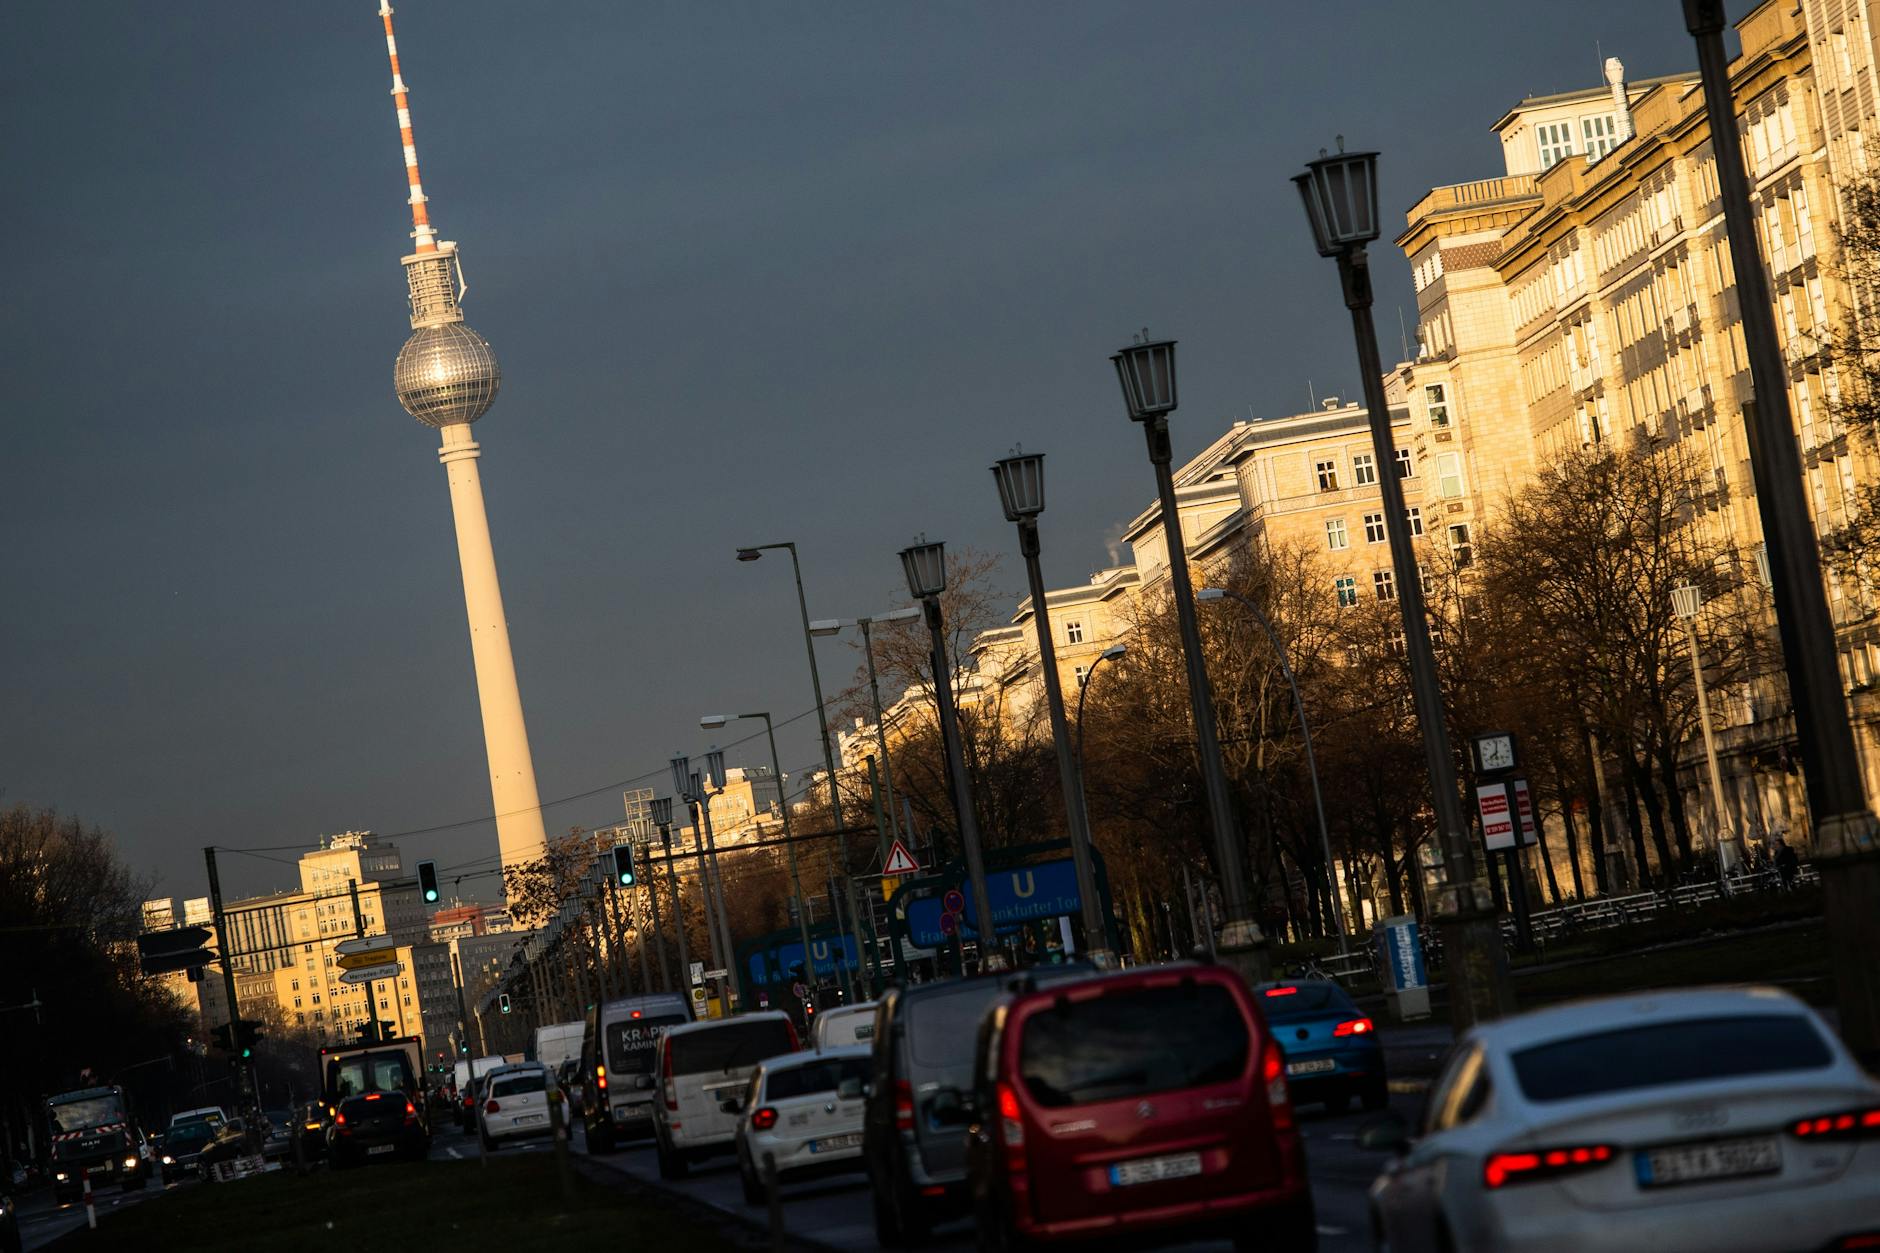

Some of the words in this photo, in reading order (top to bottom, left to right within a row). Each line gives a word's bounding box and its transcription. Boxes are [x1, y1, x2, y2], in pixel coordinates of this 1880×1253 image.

[1011, 871, 1035, 898] U
[991, 901, 1053, 921] ankfurter
[812, 941, 828, 960] U
